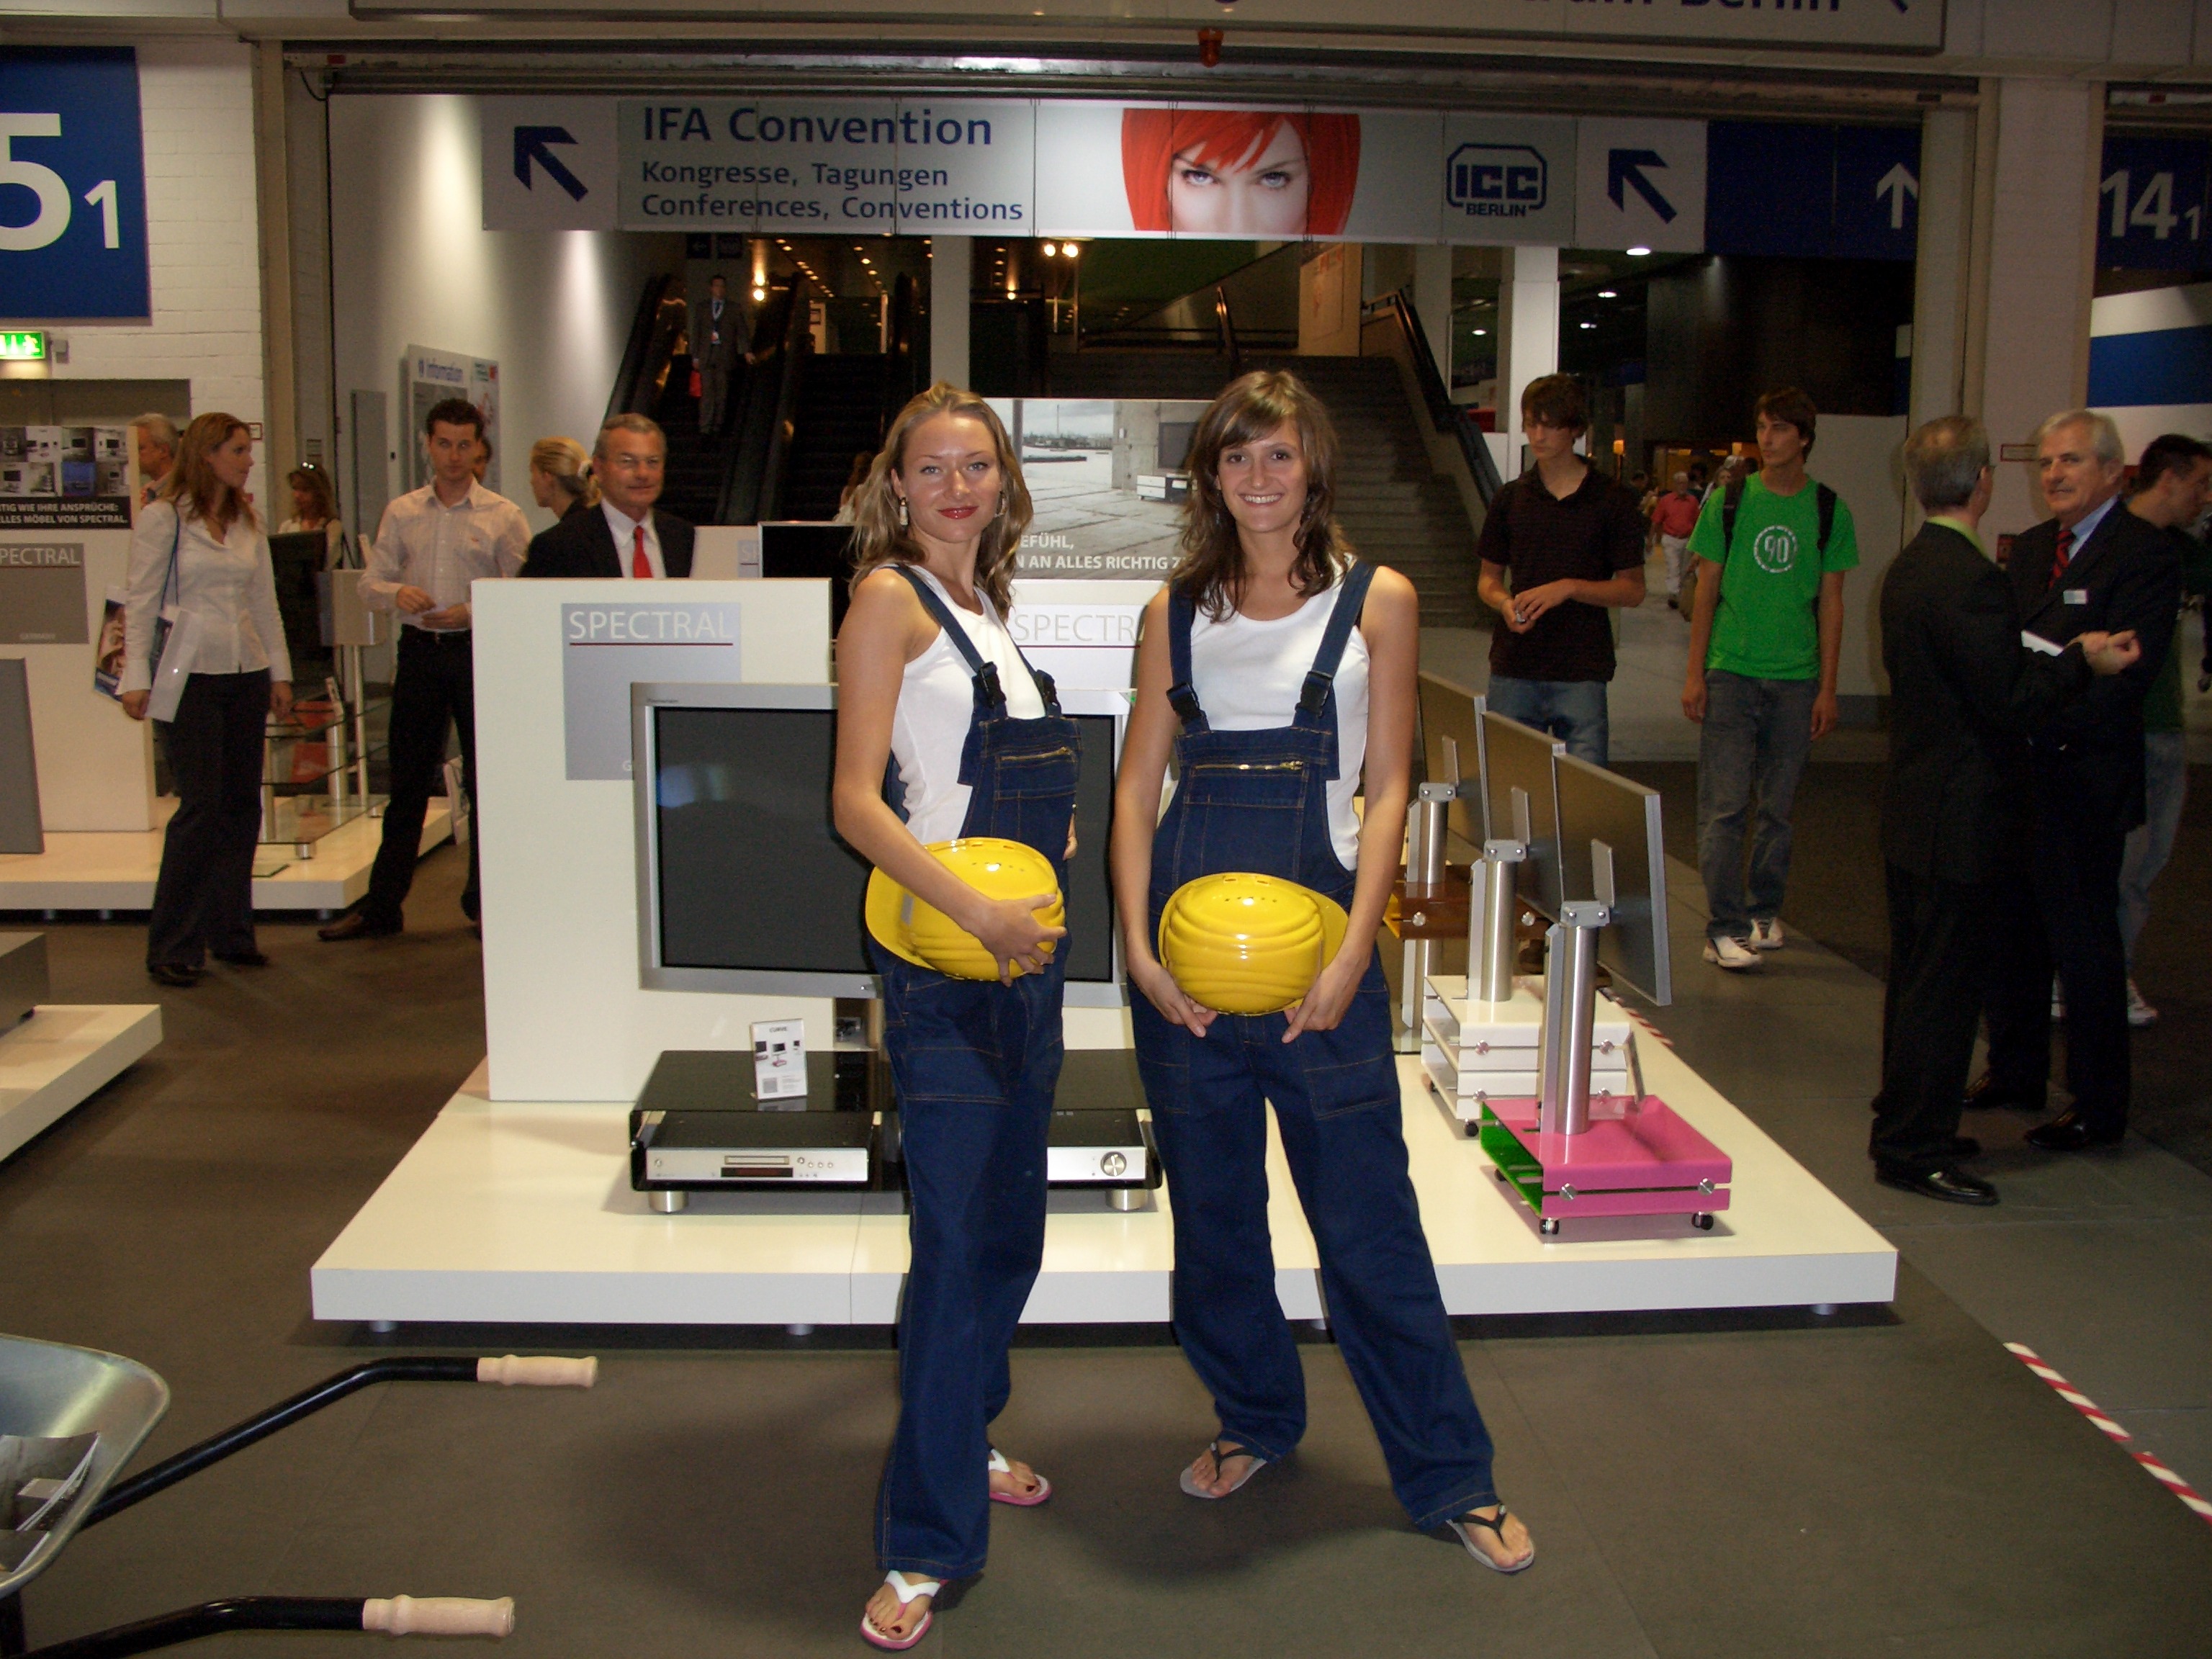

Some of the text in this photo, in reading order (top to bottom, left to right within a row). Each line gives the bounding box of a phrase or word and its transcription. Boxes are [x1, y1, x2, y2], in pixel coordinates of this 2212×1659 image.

[642, 107, 992, 145] IFA Convention
[642, 161, 948, 191] Kongresse, Tagungen
[1455, 164, 1538, 199] ICC
[642, 194, 1023, 221] Conferences, Conventions
[1465, 202, 1527, 216] BERLIN
[17, 503, 35, 512] WIE
[37, 503, 59, 512] IHRE
[56, 515, 78, 523] VON
[1028, 555, 1051, 569] AN
[1055, 555, 1102, 569] ALLES
[1105, 556, 1169, 570] RICHTIG
[569, 611, 734, 640] SPECTRAL
[1014, 613, 1136, 642] SPECTR
